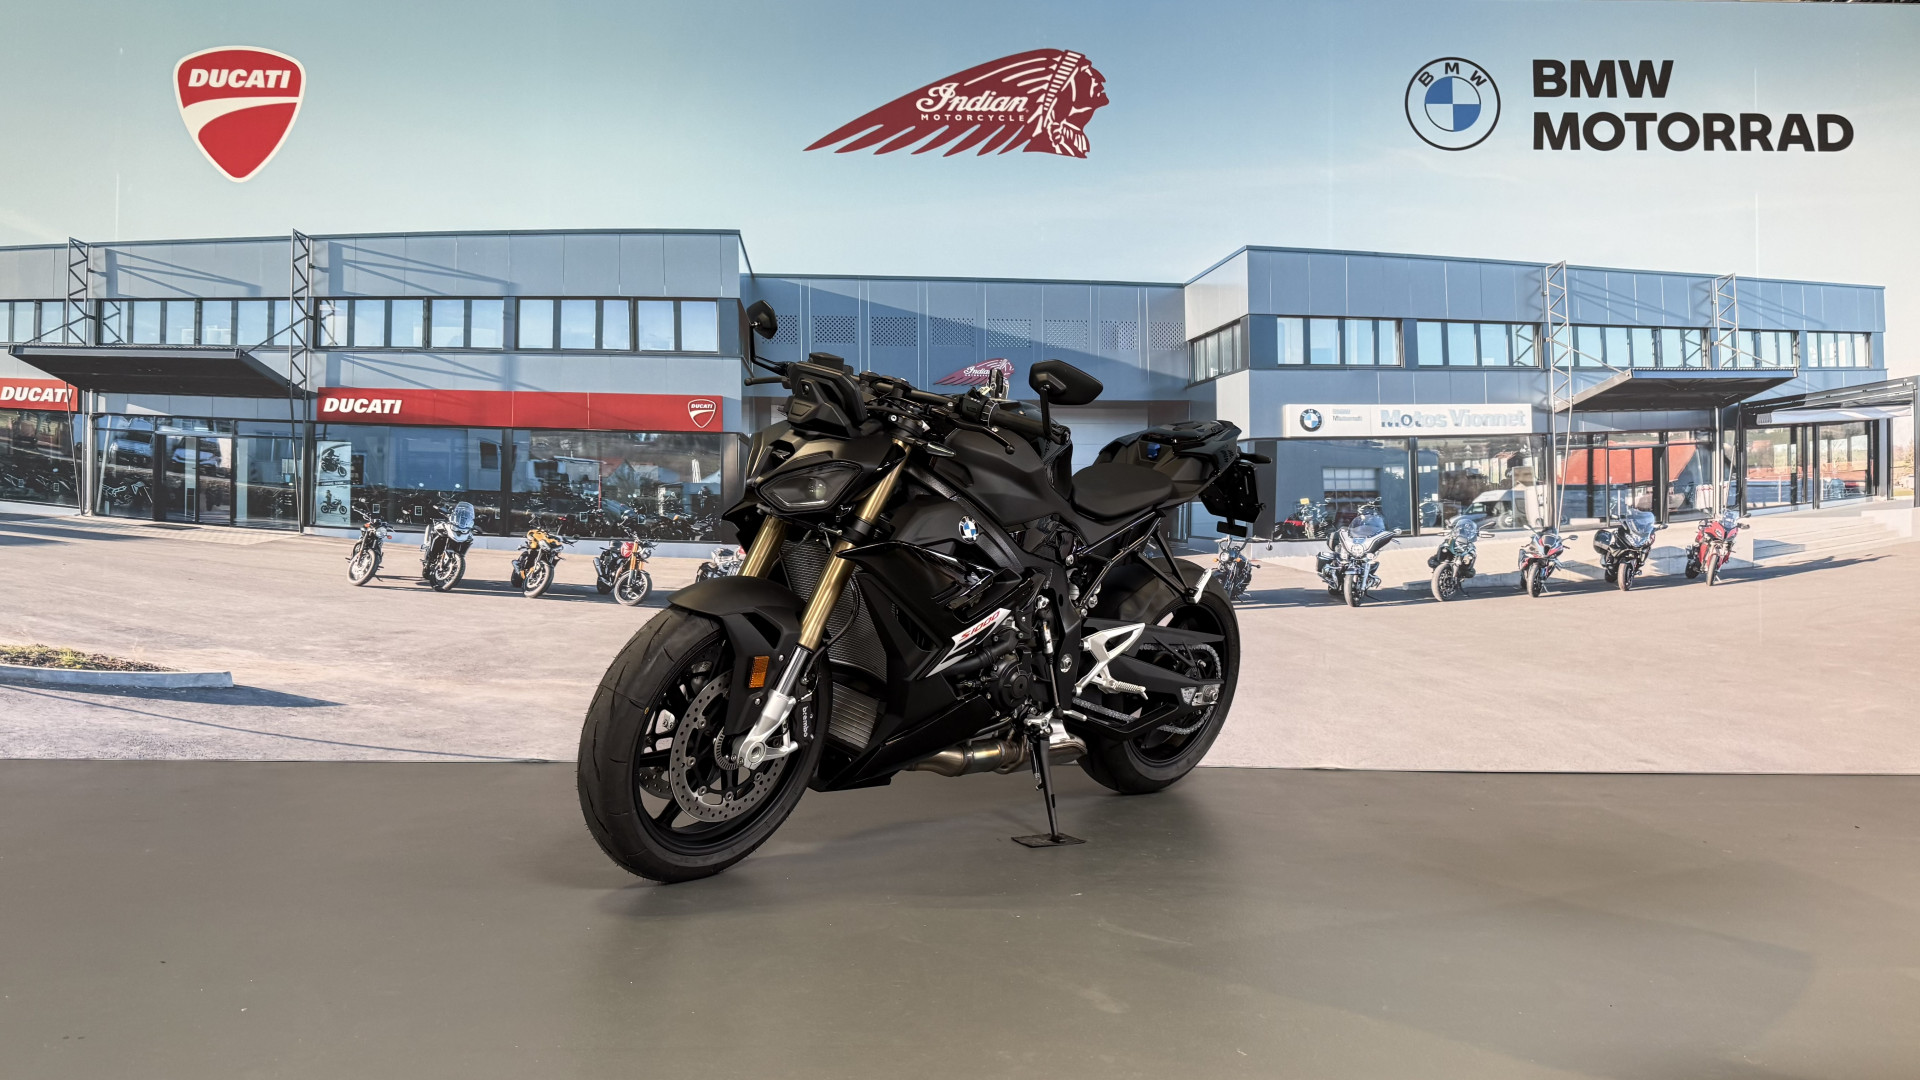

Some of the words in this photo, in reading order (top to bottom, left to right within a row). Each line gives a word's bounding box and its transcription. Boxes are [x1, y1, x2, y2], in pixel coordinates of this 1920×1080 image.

[188, 68, 291, 88] DUCATI
[1418, 62, 1488, 87] BMW
[1532, 59, 1674, 98] BMW
[916, 82, 1029, 112] Indian
[920, 113, 1025, 122] MOTORCYCLE
[1533, 111, 1855, 152] MOTORRAD
[0, 386, 73, 402] DUCATI
[323, 397, 402, 414] DUCATI
[1380, 409, 1447, 427] Motos
[1448, 409, 1526, 427] Vionnet
